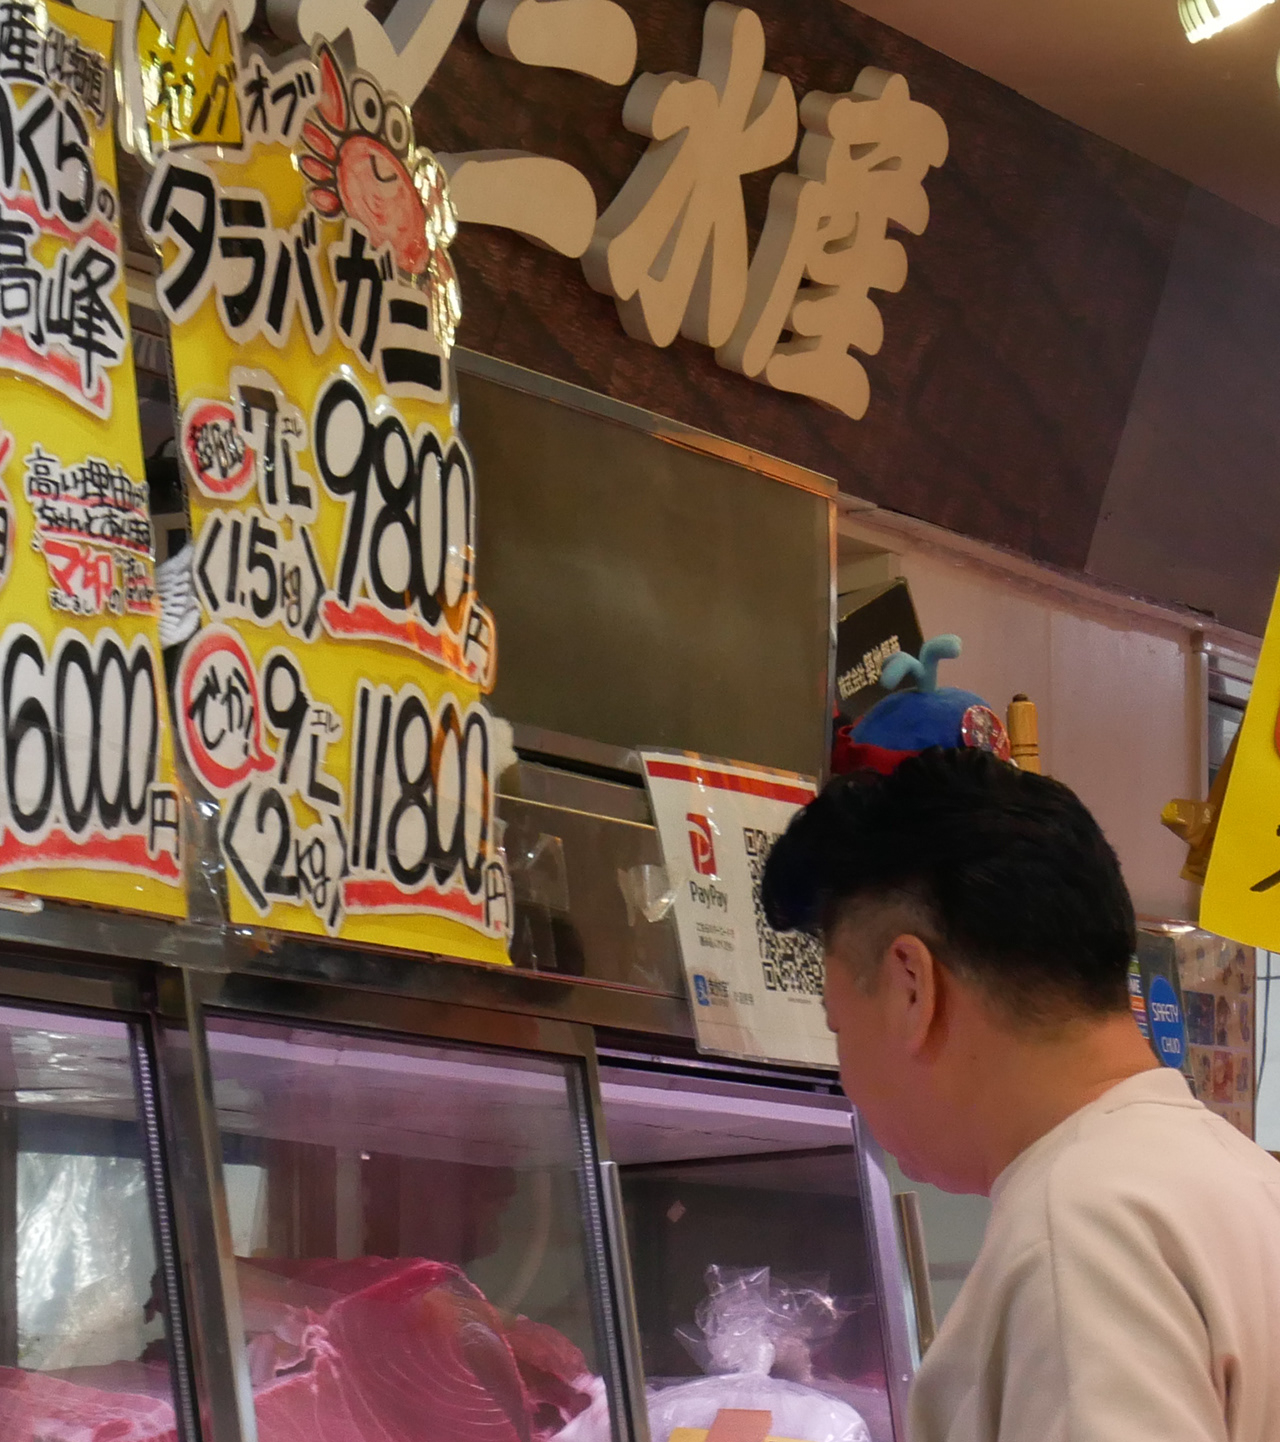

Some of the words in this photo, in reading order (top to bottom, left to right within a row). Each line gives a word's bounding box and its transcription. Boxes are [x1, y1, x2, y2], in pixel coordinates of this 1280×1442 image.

[149, 165, 443, 392] タラバガニ
[689, 880, 729, 913] PayPay
[1151, 1002, 1180, 1024] SAFETY
